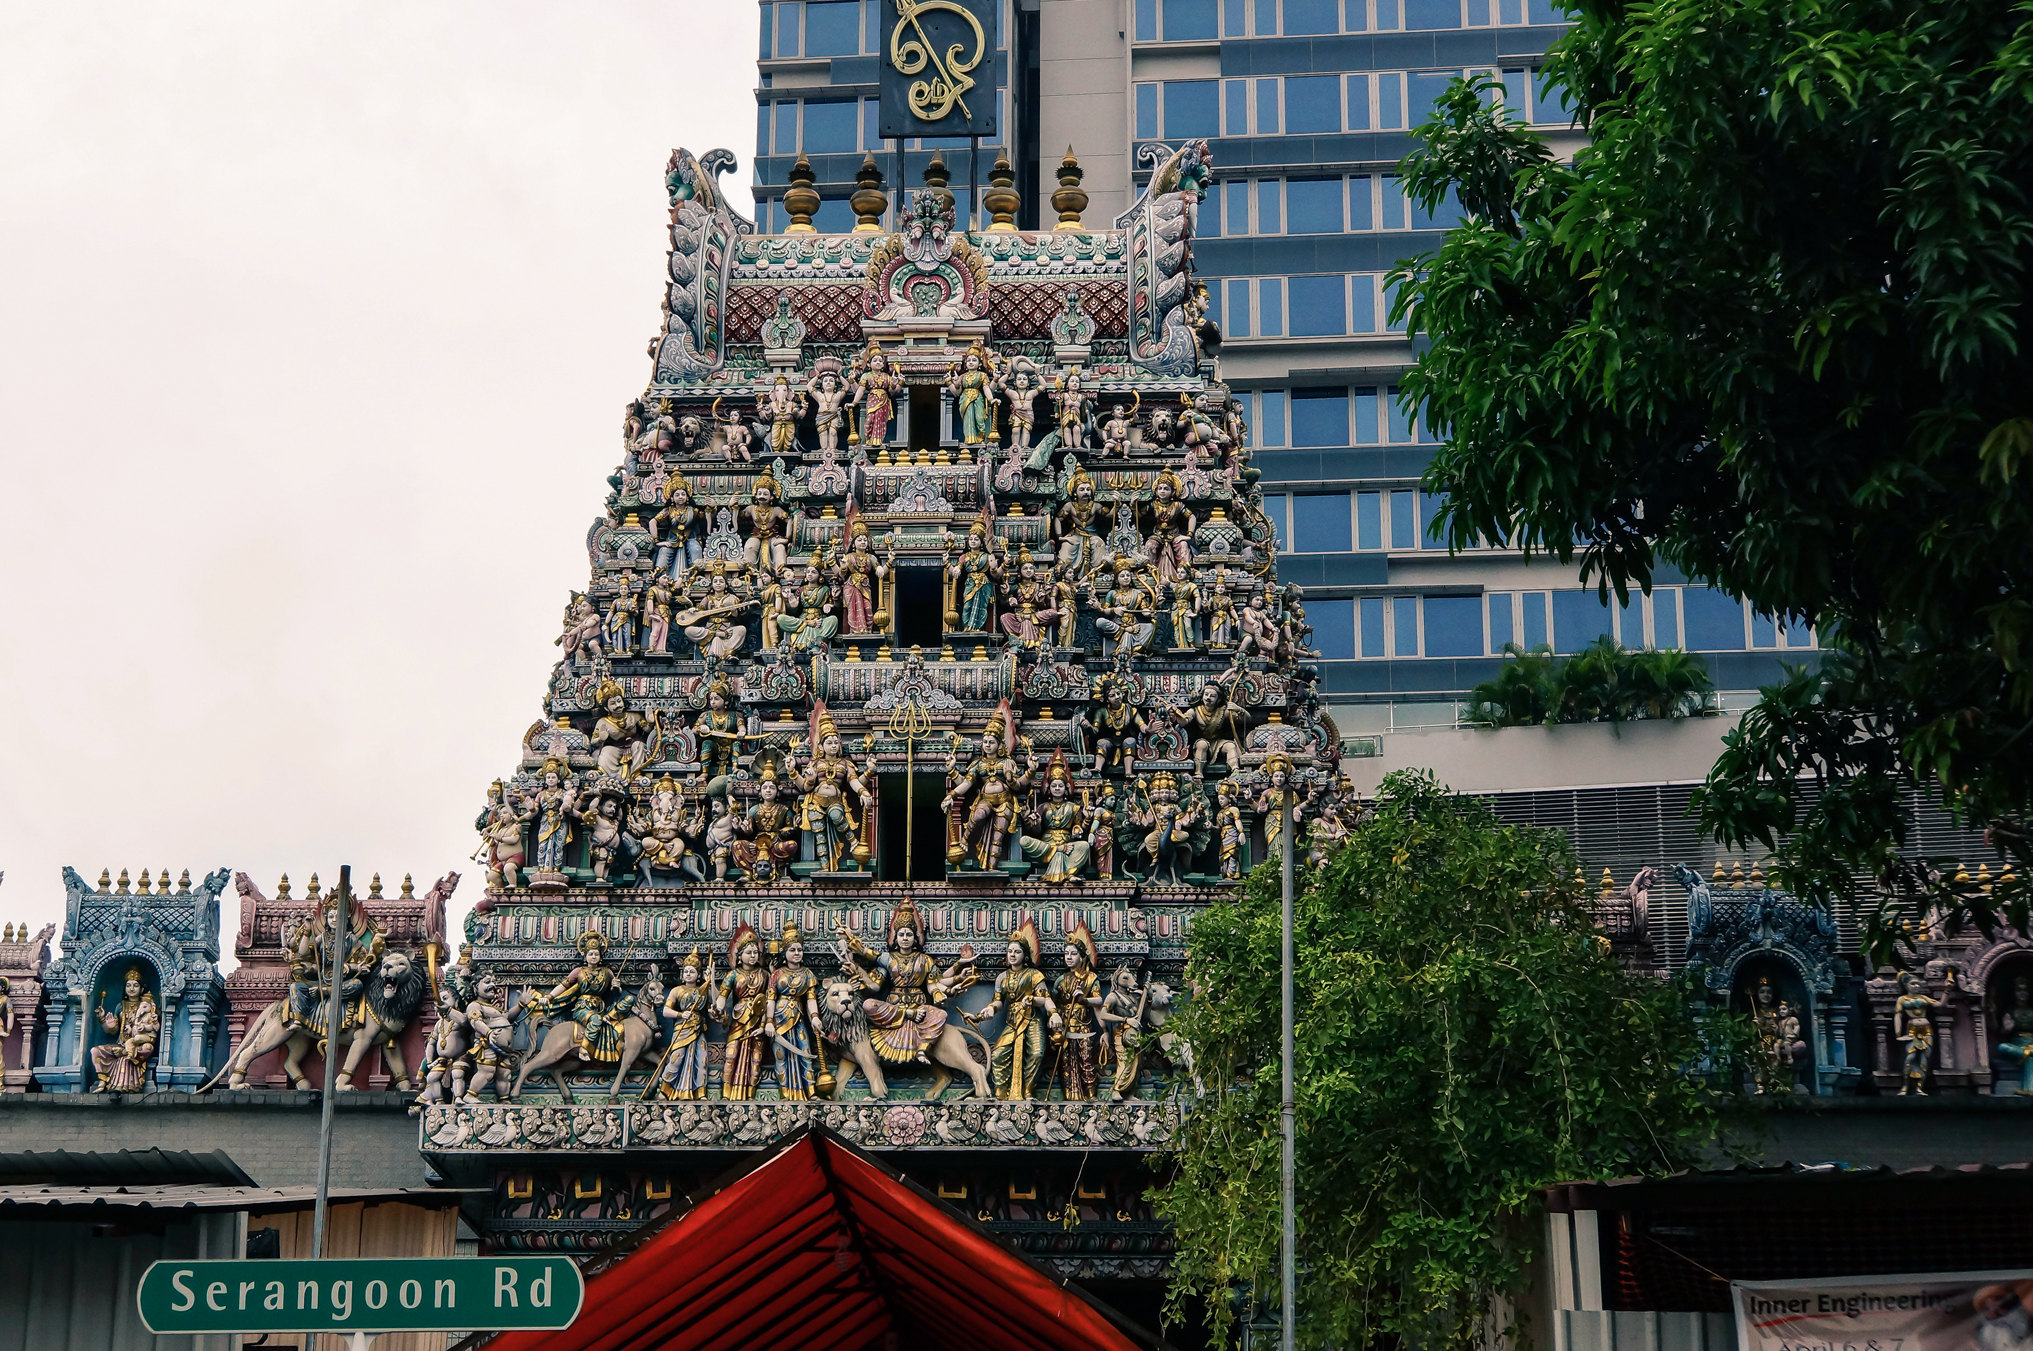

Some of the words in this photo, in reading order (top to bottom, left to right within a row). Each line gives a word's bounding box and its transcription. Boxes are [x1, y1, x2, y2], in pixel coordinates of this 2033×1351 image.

[171, 1269, 457, 1321] Serangoon
[493, 1266, 553, 1308] Rd
[1750, 1296, 1811, 1315] Inner
[1890, 1338, 1904, 1351] 7
